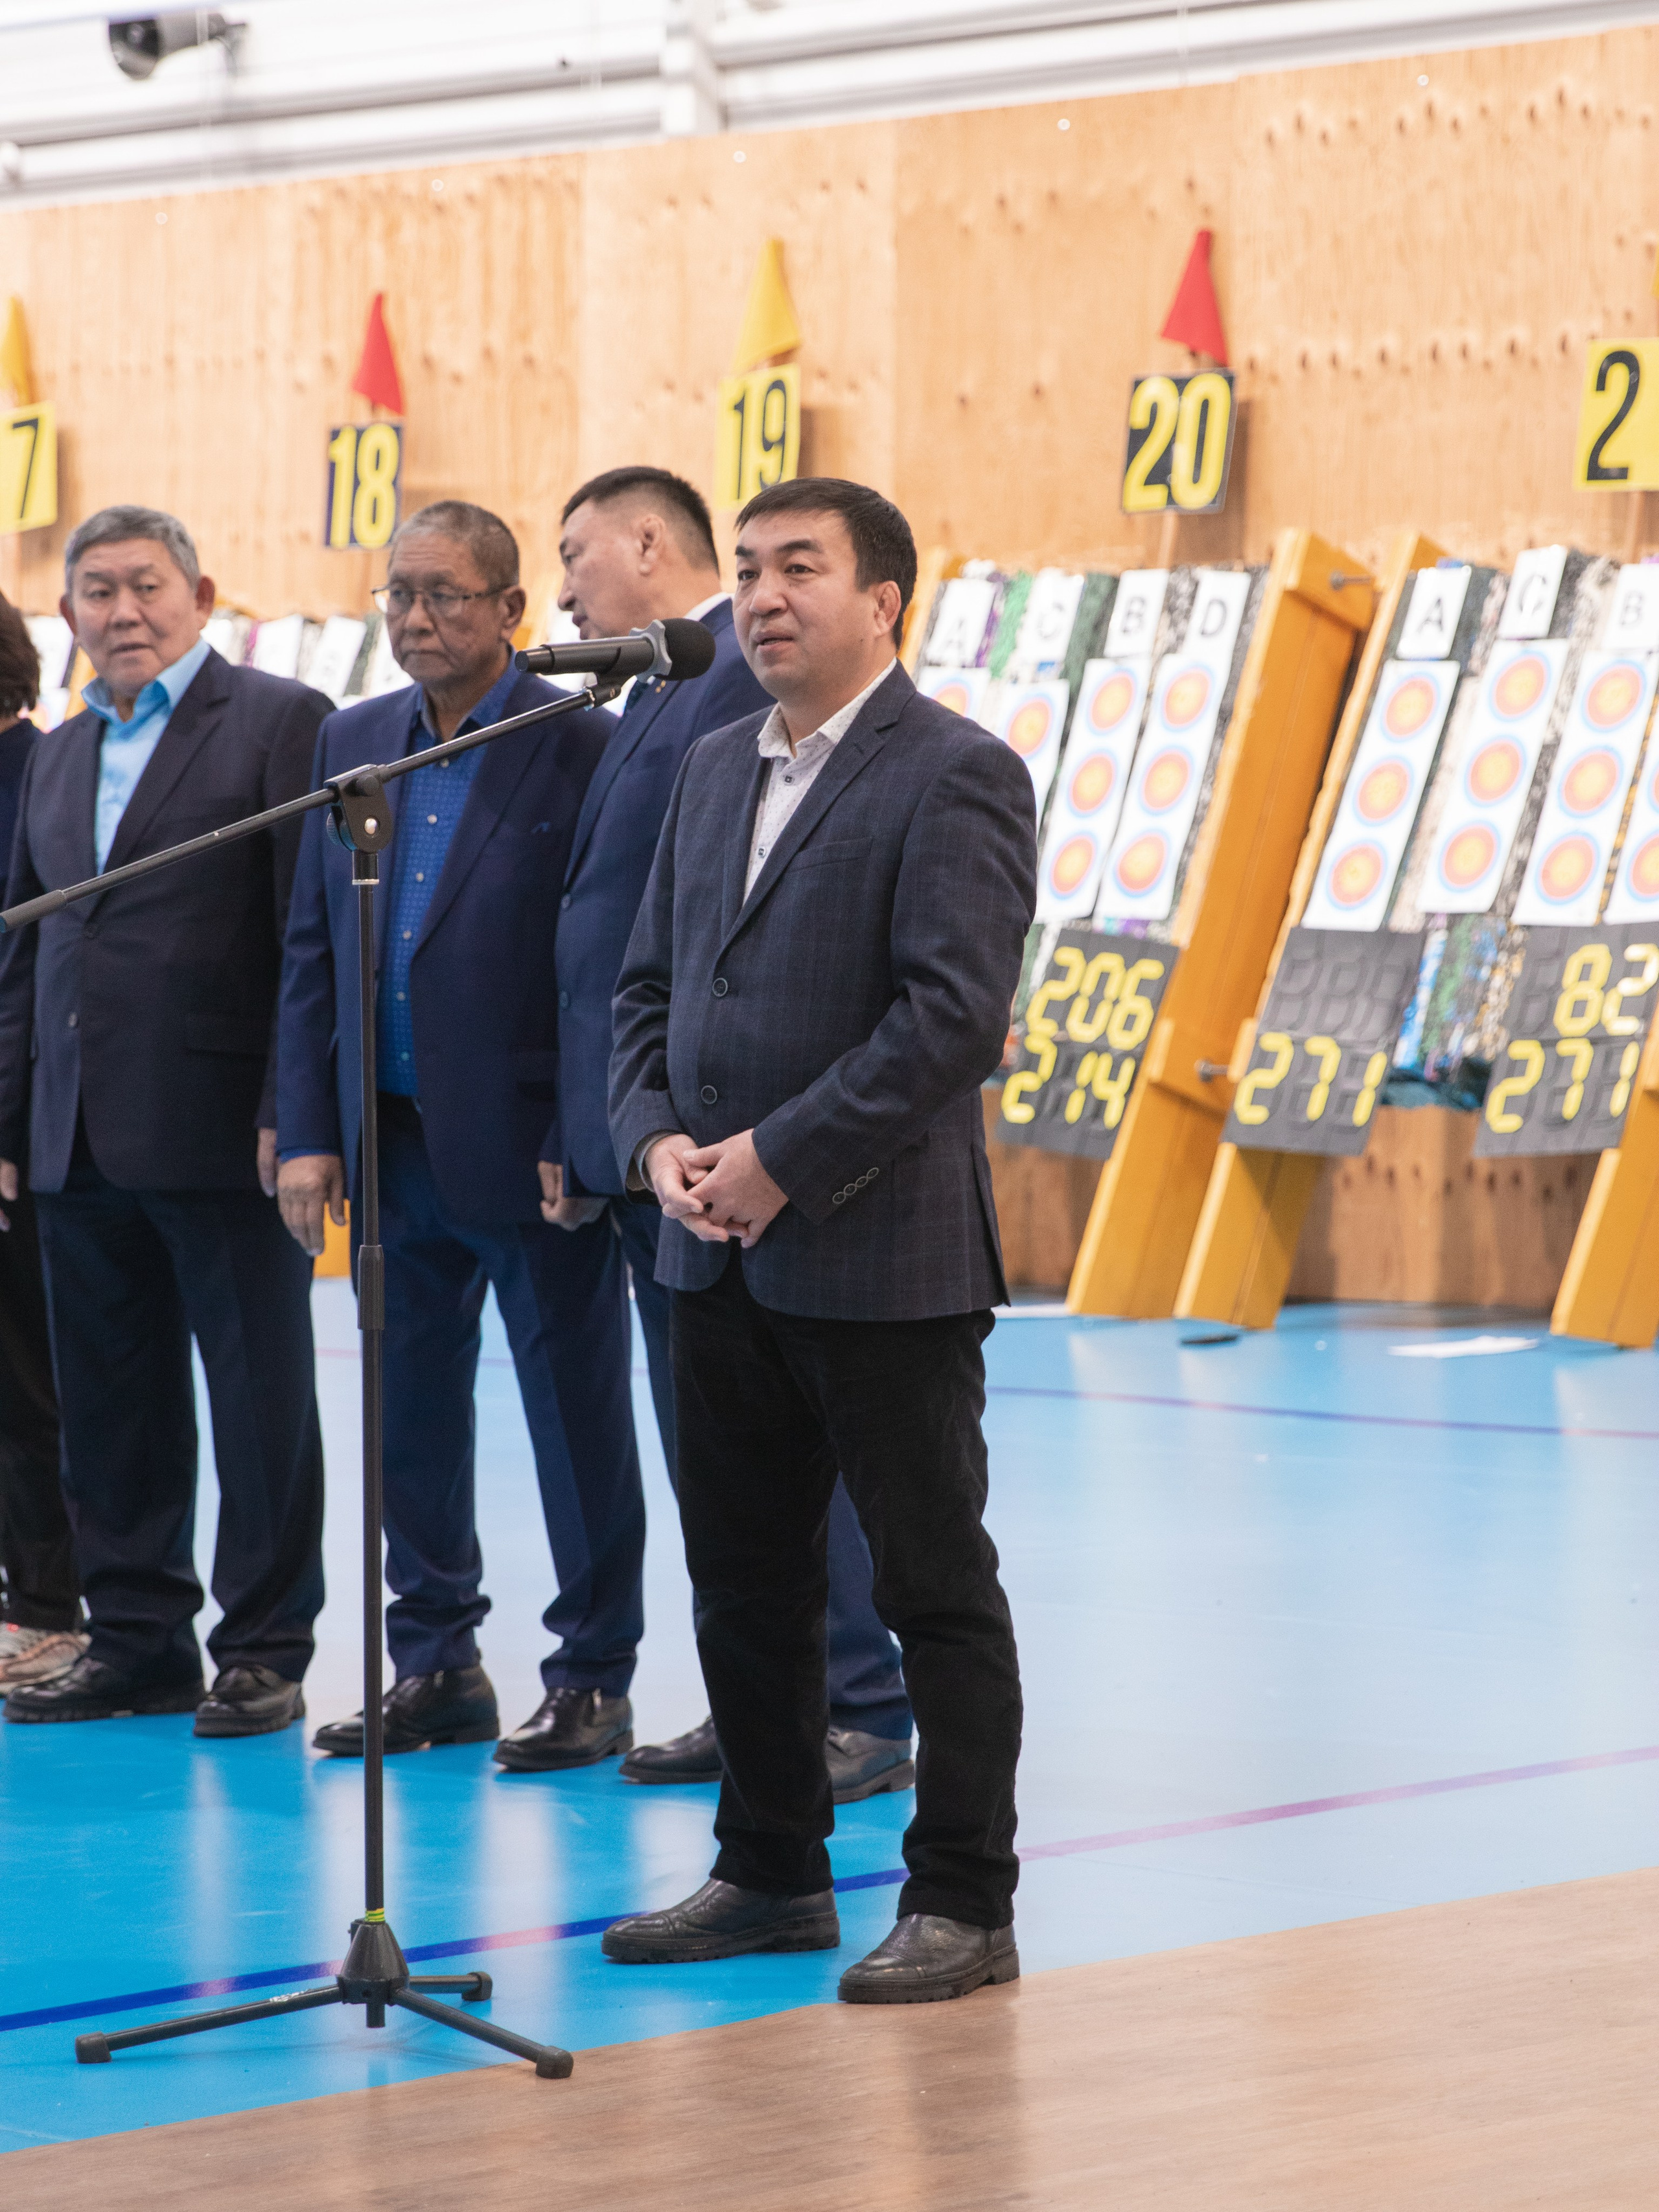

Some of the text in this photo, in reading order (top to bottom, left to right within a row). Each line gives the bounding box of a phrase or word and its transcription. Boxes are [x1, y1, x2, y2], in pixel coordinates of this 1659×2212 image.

[733, 378, 787, 500] 19
[1123, 373, 1231, 513] 20
[1586, 350, 1640, 481] 2
[329, 423, 400, 548] 18
[1120, 596, 1148, 636] B
[1200, 598, 1228, 638] D
[1416, 596, 1444, 633] A
[1517, 574, 1548, 615] C
[1619, 590, 1645, 628] B
[1026, 946, 1165, 1051] 206
[1553, 943, 1659, 1037] 82
[1001, 1034, 1135, 1129] 214
[1234, 1032, 1387, 1127] 271
[1485, 1038, 1640, 1134] 271
